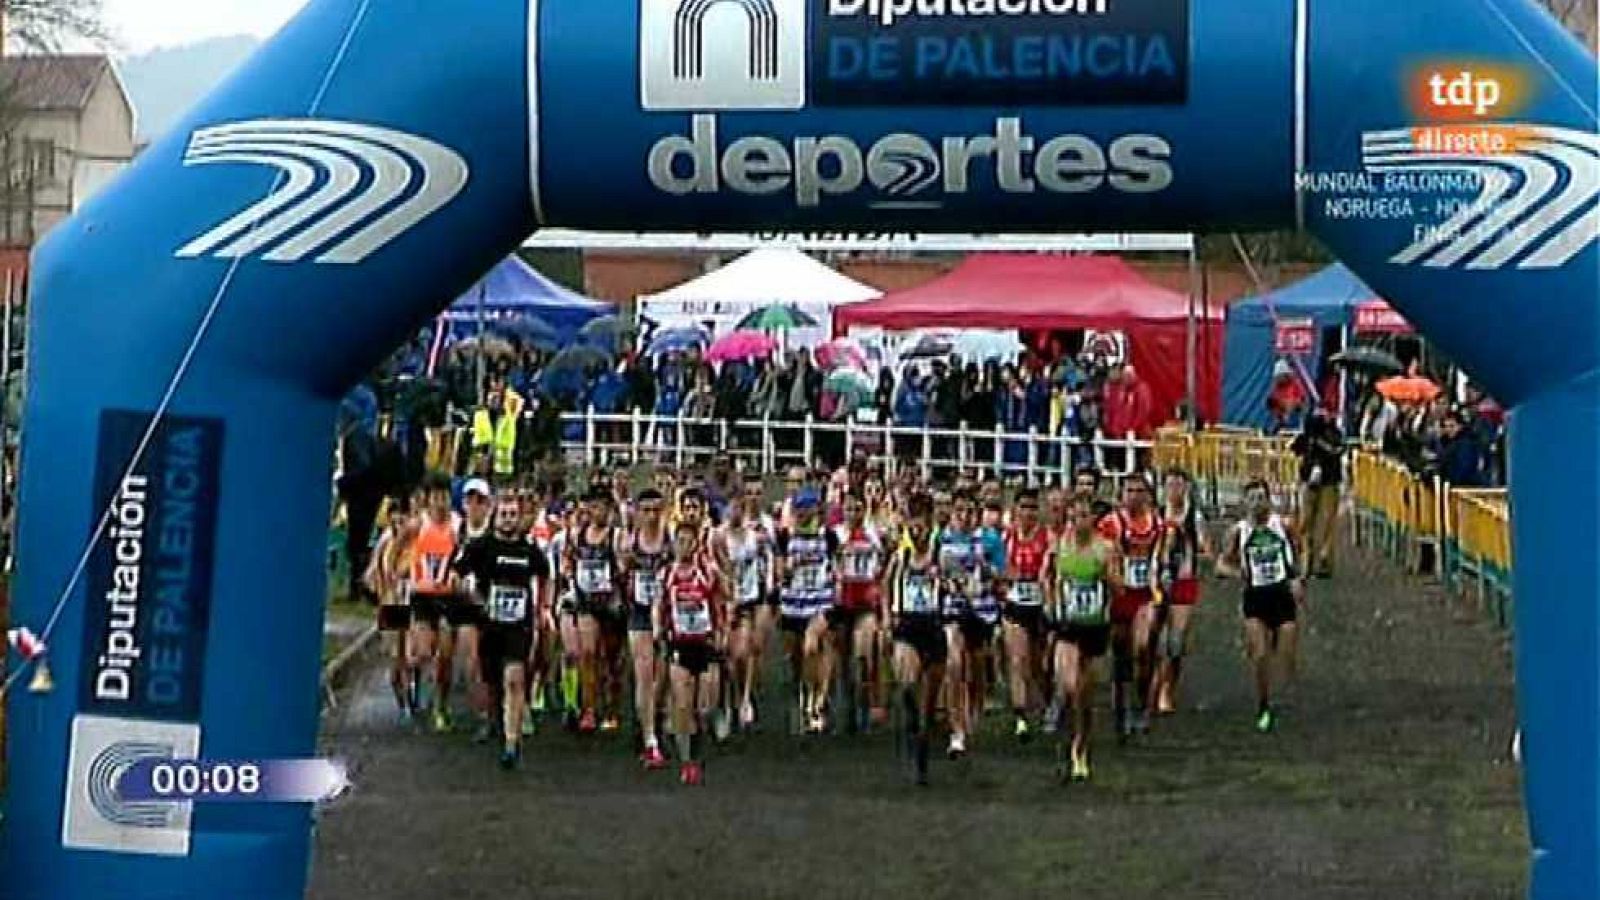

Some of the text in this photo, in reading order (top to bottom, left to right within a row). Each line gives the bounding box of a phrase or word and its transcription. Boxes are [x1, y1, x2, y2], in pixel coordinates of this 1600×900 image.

[829, 35, 1176, 77] DE PALENCIA
[648, 113, 1174, 206] deportes
[96, 474, 148, 700] Diputación
[147, 426, 203, 704] DE PALENCIA
